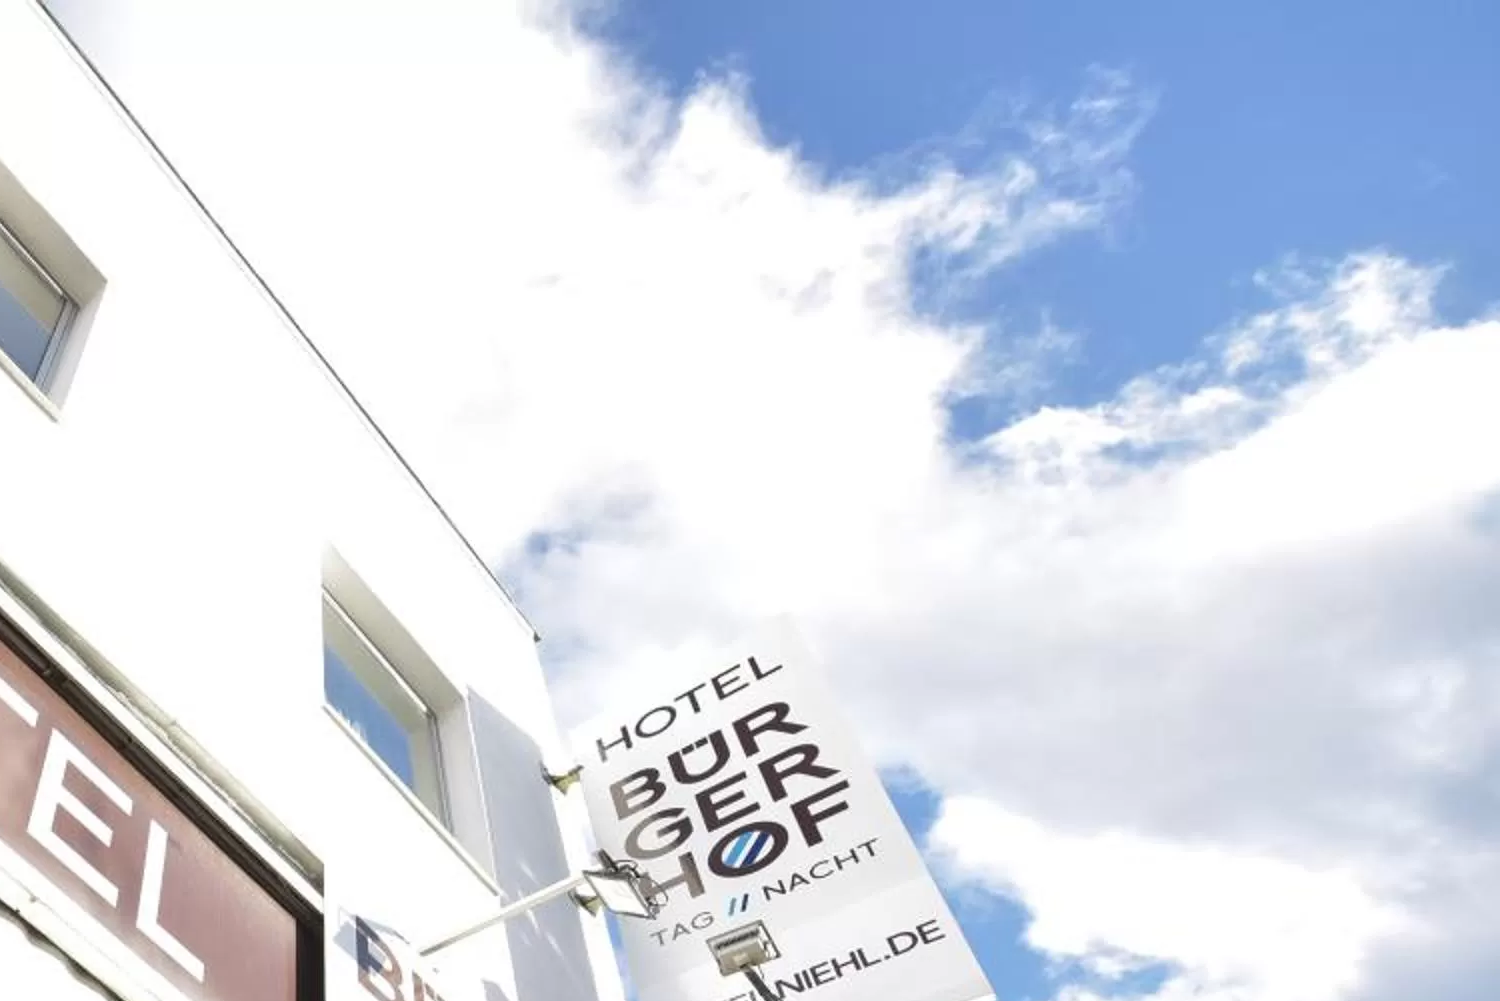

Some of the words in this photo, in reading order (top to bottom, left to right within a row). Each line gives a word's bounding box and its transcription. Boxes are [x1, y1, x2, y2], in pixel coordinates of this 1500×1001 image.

[595, 656, 783, 763] HOTEL
[609, 701, 809, 820] BÜR
[624, 743, 842, 861] GER
[636, 780, 850, 906] HOF
[650, 911, 714, 946] TAG
[763, 838, 880, 901] NACHT
